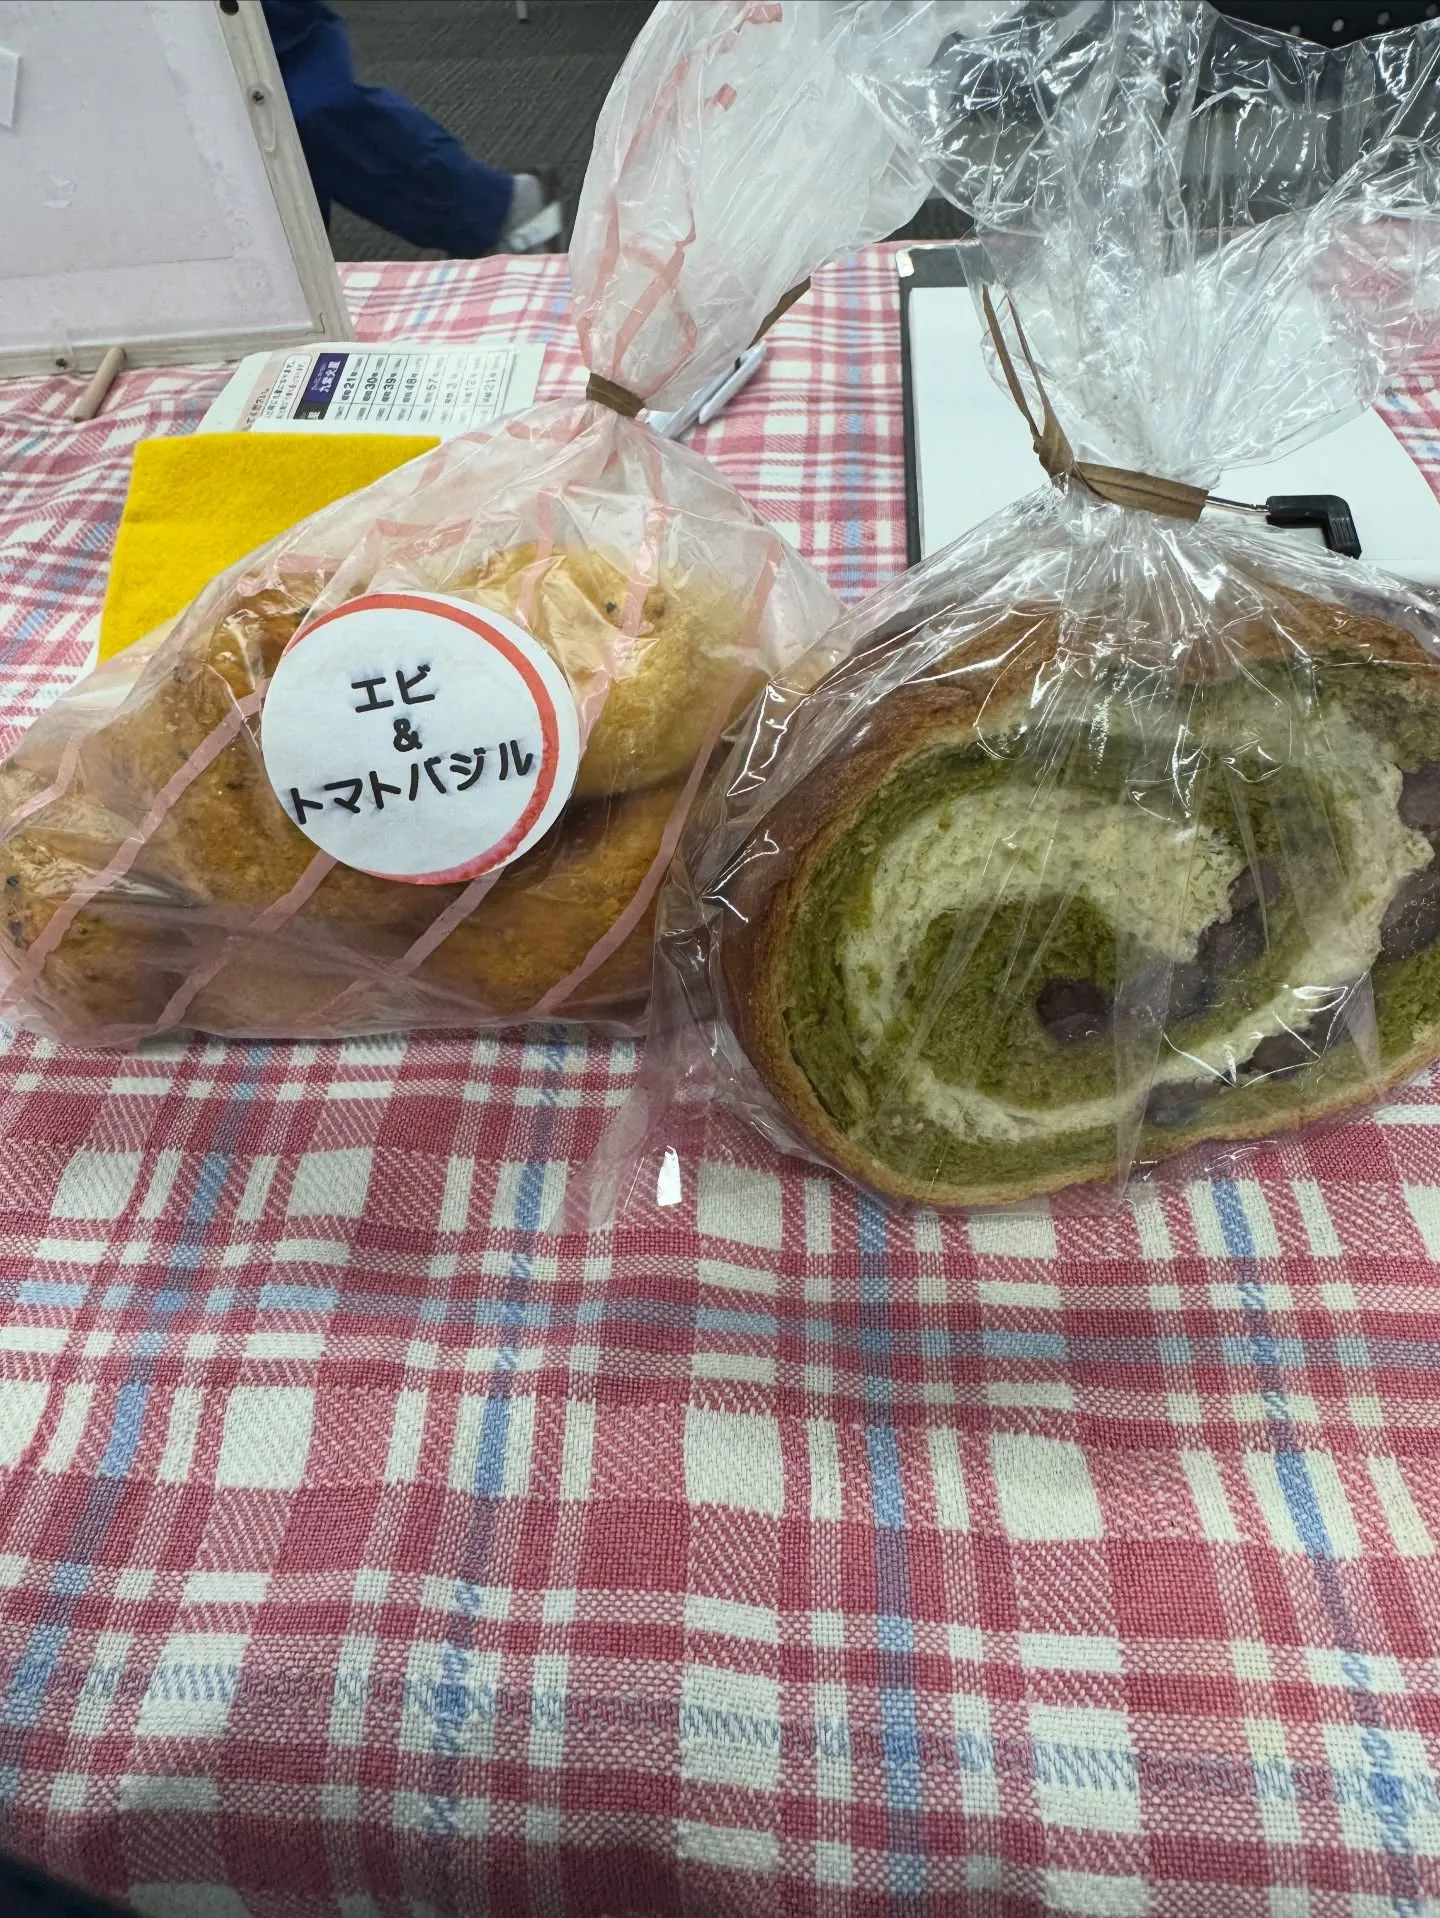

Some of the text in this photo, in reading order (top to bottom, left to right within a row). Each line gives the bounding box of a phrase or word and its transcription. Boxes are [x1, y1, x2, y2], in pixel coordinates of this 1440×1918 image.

[351, 664, 435, 713] エビ
[393, 718, 423, 752] &
[290, 740, 534, 825] トマトバジル
